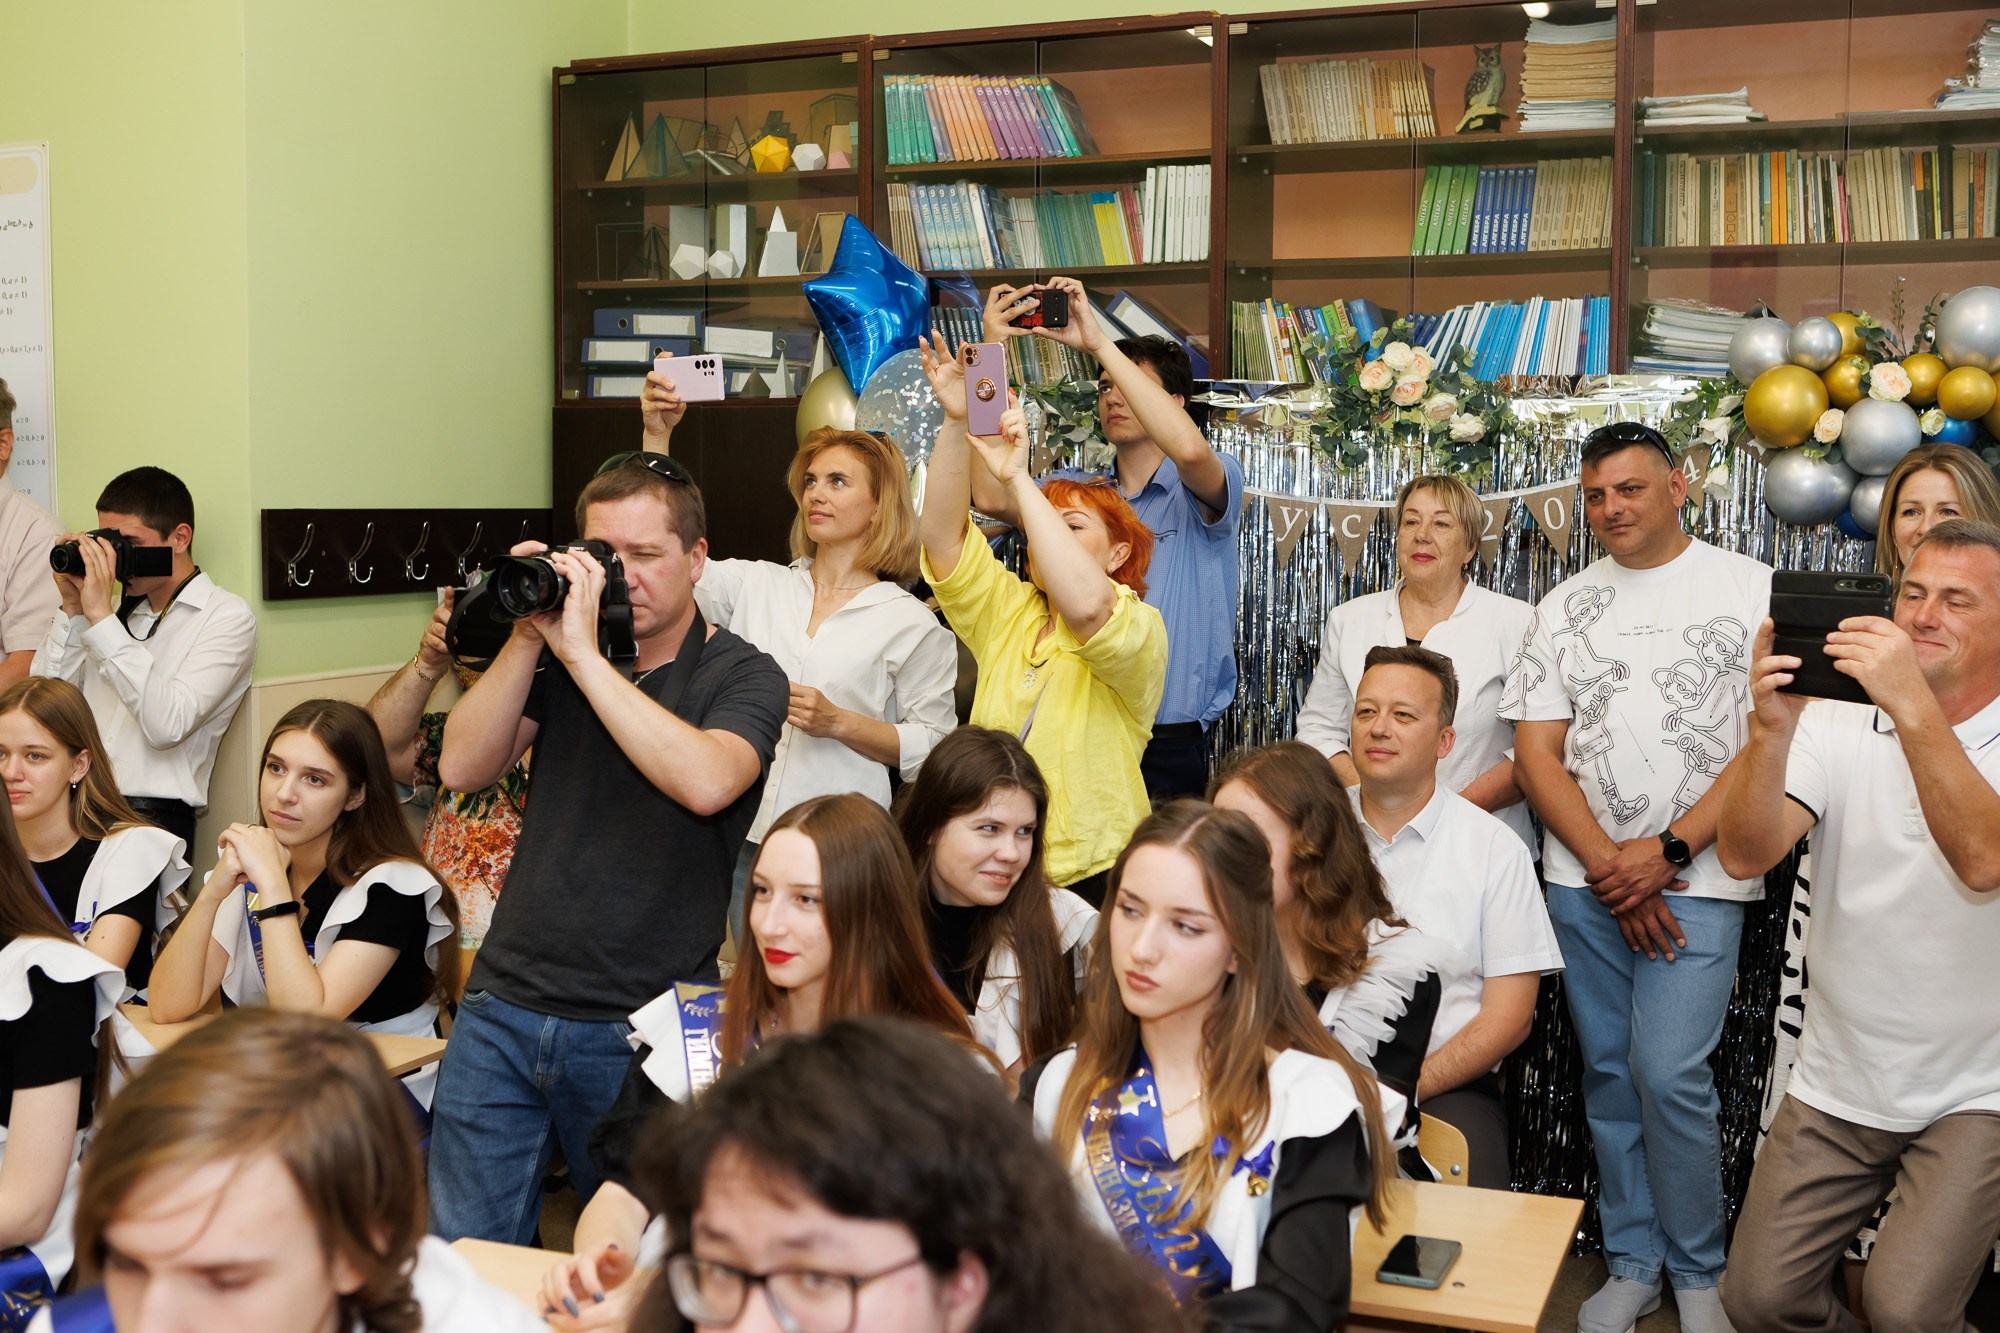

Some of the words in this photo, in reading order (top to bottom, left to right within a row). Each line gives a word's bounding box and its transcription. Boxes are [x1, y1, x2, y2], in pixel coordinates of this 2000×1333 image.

[1003, 87, 1010, 95] 8
[1014, 88, 1020, 96] 8
[920, 189, 925, 197] 9
[930, 189, 935, 197] 9
[940, 189, 945, 197] 9
[950, 188, 956, 196] 9
[1419, 200, 1428, 227] АЛГЕБРА
[1433, 200, 1442, 226] АЛГЕБРА
[1447, 200, 1456, 228] АЛГЕБРА
[1461, 199, 1470, 226] АЛГЕБРА
[1472, 214, 1481, 246] АЛГЕБРА
[1481, 215, 1490, 247] АЛГЕБРА
[1491, 214, 1500, 246] АЛГЕБРА
[1501, 214, 1509, 246] АЛГЕБРА
[1510, 214, 1519, 246] АЛГЕБРА
[1520, 213, 1529, 246] АЛГЕБРА
